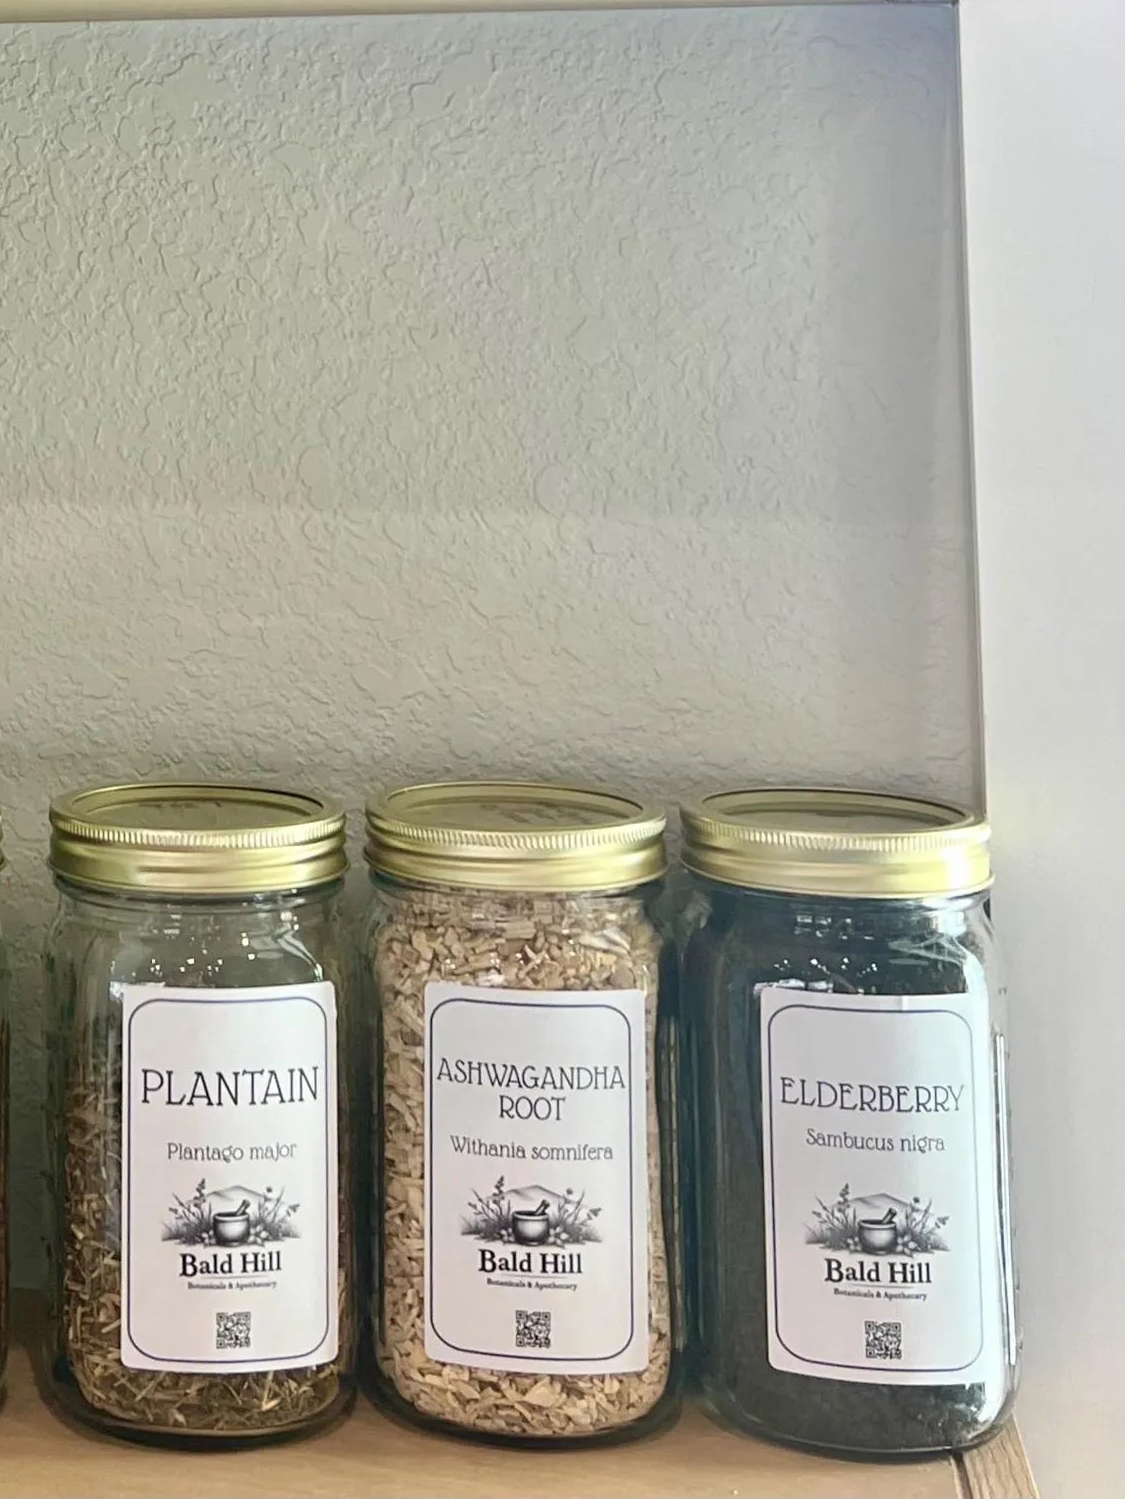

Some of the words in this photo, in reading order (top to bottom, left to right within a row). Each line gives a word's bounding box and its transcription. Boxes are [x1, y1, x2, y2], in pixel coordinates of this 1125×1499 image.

[141, 1065, 319, 1107] PLANTAIN
[436, 1057, 627, 1091] ASHWAGANDHA
[779, 1075, 966, 1114] ELDERBERRY
[498, 1095, 566, 1121] ROOT
[167, 1142, 245, 1164] Plantago
[249, 1142, 297, 1162] major
[449, 1134, 527, 1160] Withania
[531, 1142, 613, 1162] somnifera
[805, 1128, 895, 1153] Sambucus
[899, 1135, 946, 1154] nigra
[179, 1252, 234, 1277] Bald
[240, 1250, 282, 1272] Hill
[478, 1249, 532, 1274] Bald
[539, 1252, 583, 1274] Hill
[824, 1258, 881, 1283] Bald
[888, 1260, 933, 1283] Hill
